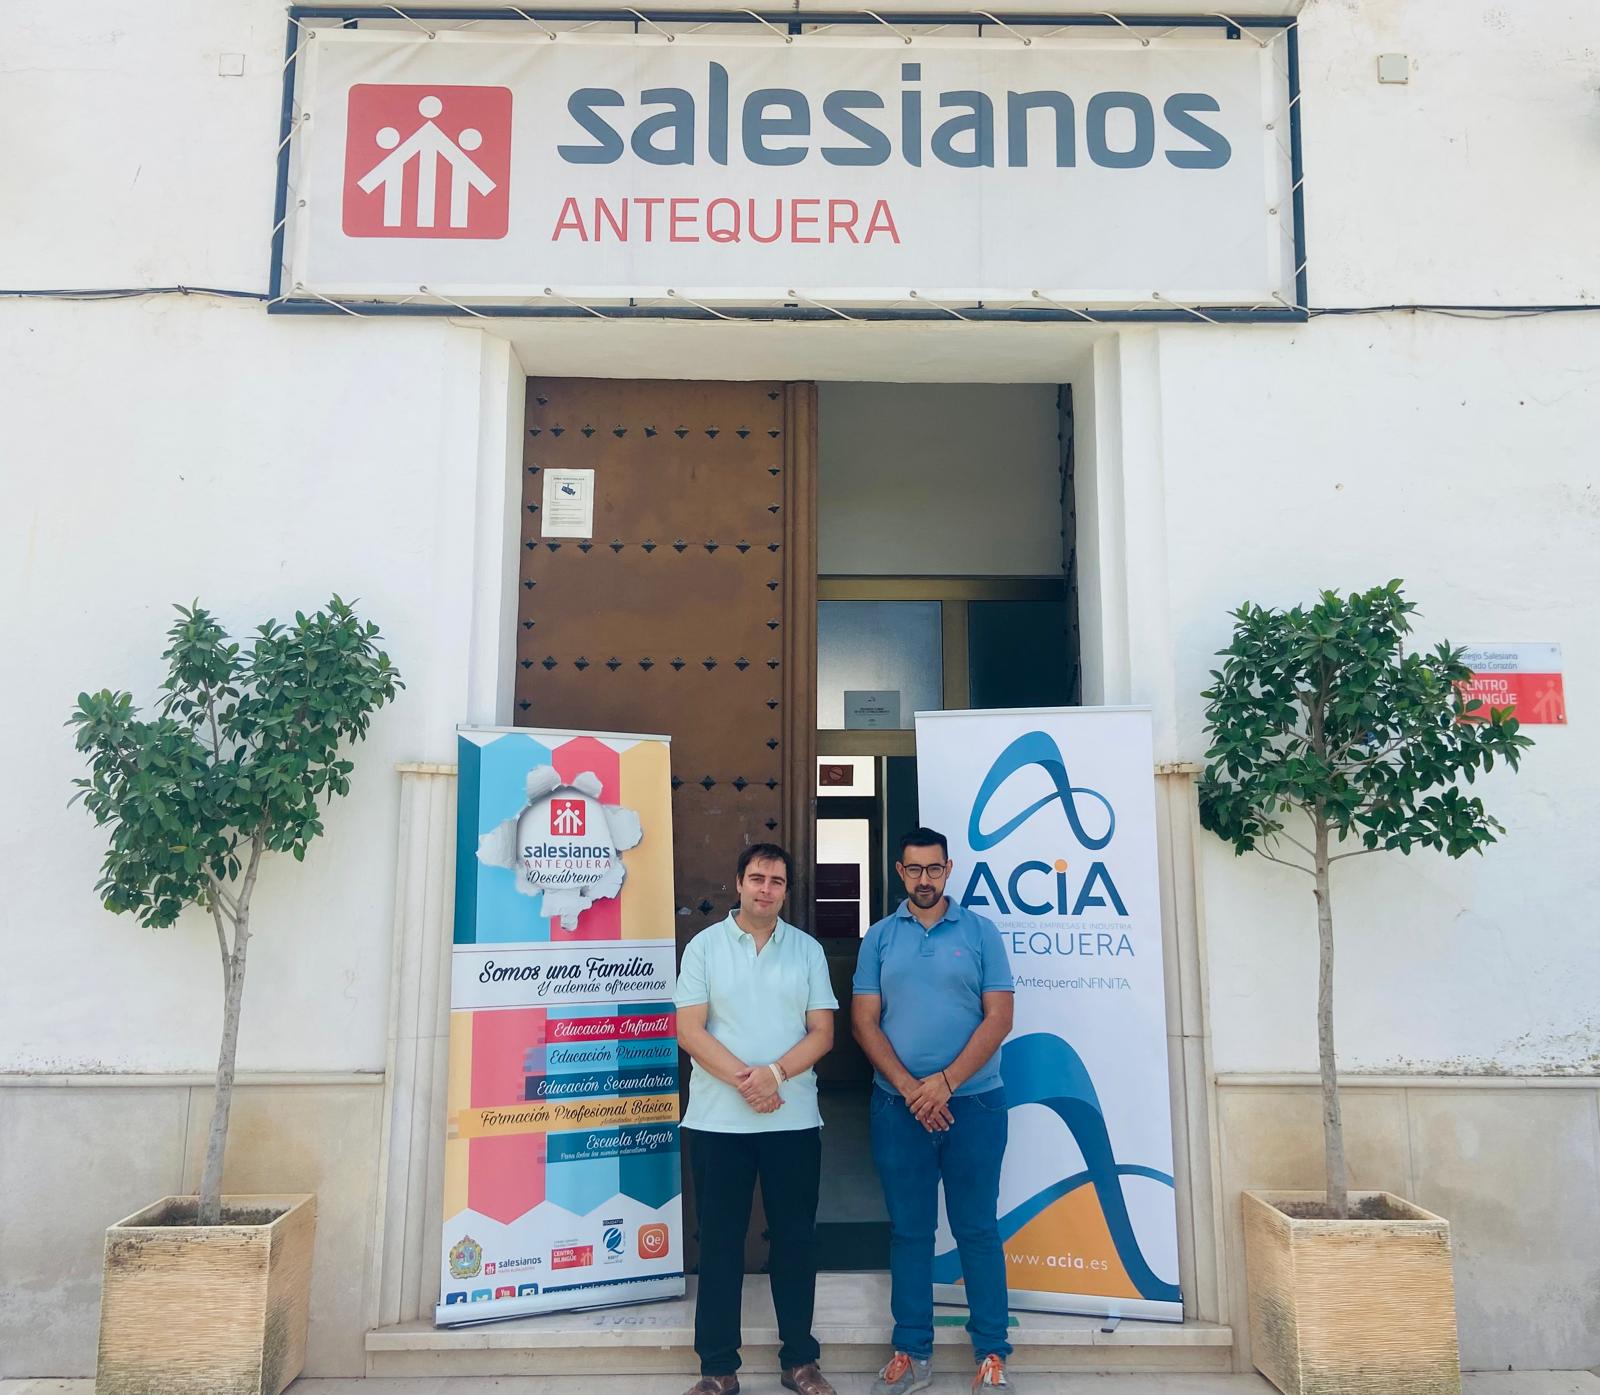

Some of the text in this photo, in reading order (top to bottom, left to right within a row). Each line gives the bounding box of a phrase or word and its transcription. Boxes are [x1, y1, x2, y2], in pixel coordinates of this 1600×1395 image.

[557, 61, 1232, 169] salesianos
[551, 198, 901, 244] ANTEQUERA
[1461, 652, 1518, 662] olegio Salesiano
[1488, 661, 1518, 670] Corazón
[524, 842, 610, 858] salesianos
[524, 860, 611, 869] ANTEQUERA
[1040, 922, 1079, 930] EMPRESAS
[1000, 932, 1135, 957] EQUERA
[479, 957, 654, 983] Somos una Familia
[537, 978, 667, 997] Y además ofrecemos
[1012, 976, 1131, 991] AntequeraINFINITA
[554, 1017, 668, 1036] Educación Infantil
[550, 1045, 672, 1065] Educación Primaria
[537, 1073, 674, 1095] Educación Secundaria
[480, 1108, 550, 1128] Formación
[554, 1101, 627, 1122] Profesional
[631, 1098, 673, 1115] Básica
[586, 1130, 673, 1150] Escuela Hogar
[646, 1235, 661, 1246] Qe
[498, 1257, 542, 1269] salesianos
